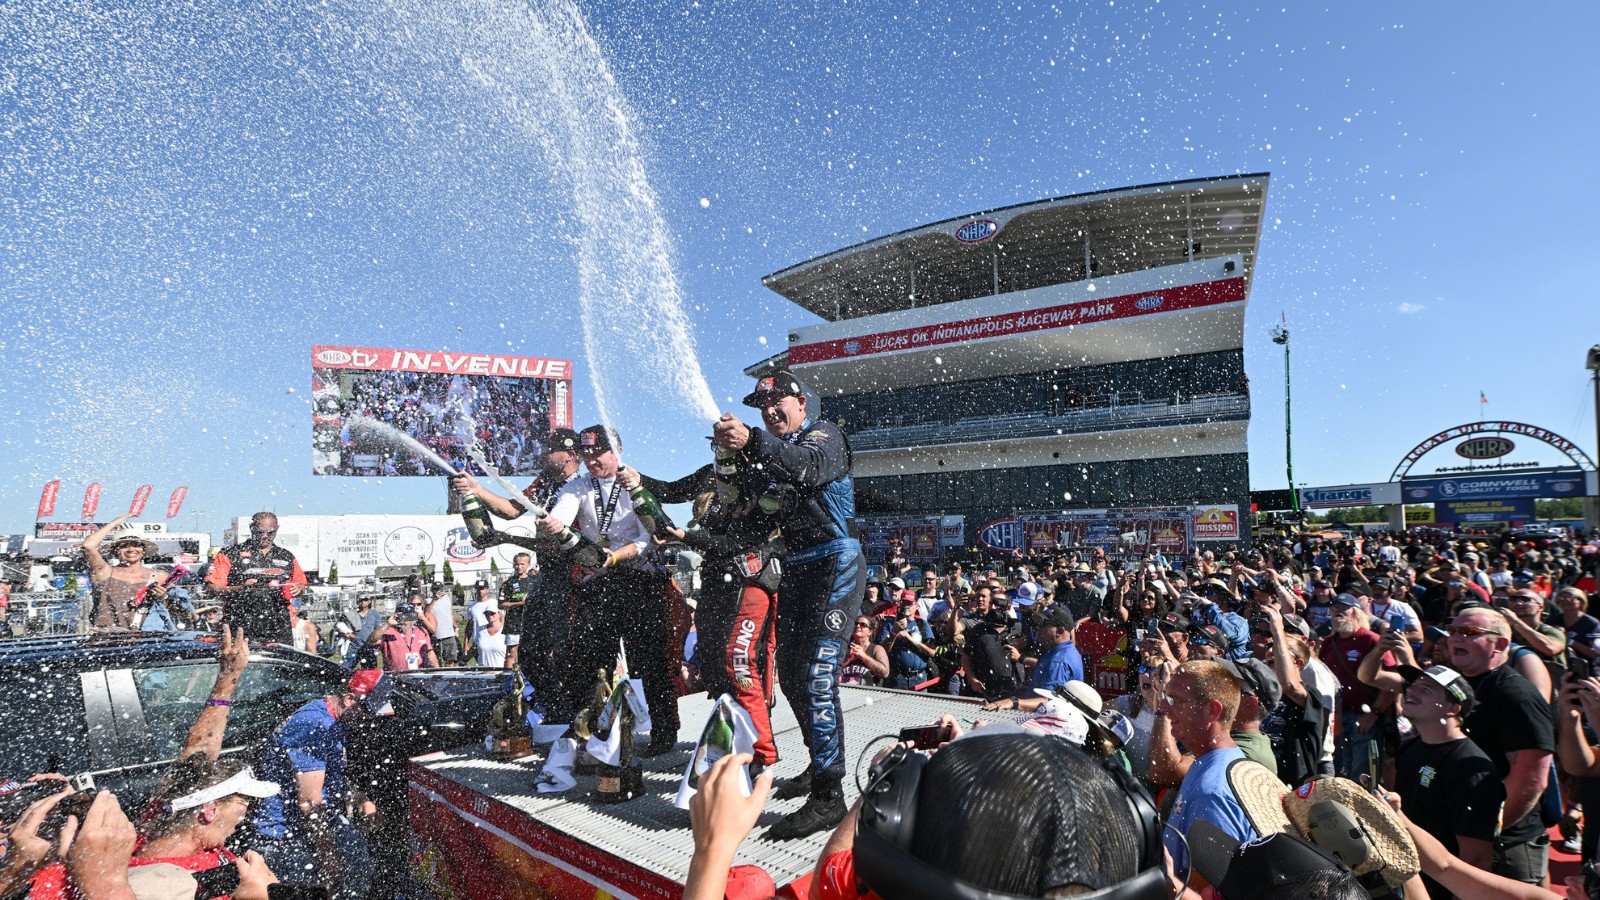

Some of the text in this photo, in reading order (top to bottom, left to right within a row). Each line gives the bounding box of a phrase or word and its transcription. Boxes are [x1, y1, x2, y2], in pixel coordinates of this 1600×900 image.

[960, 222, 995, 239] NHRA
[1137, 297, 1162, 309] NHRA
[874, 335, 909, 349] LUCAS
[912, 333, 928, 343] OIL
[932, 318, 1014, 340] INDIANAPOLIS
[1017, 309, 1078, 328] RACEWAY
[1079, 303, 1115, 319] PARK
[322, 352, 348, 361] NHRA
[391, 351, 567, 377] IN-VENUE
[1407, 422, 1575, 463] LUCAS OIL RACEWAY
[1463, 440, 1507, 457] NHRA
[1452, 461, 1539, 472] INDIANAPOLIS
[1460, 479, 1540, 489] CORNWELL
[610, 484, 620, 504] NHRA
[1303, 489, 1372, 502] Strange
[602, 511, 612, 531] NHRA
[1196, 523, 1233, 531] mission
[733, 619, 756, 682] WELLING
[852, 665, 869, 675] FAST
[579, 854, 597, 868] ROD
[601, 865, 671, 899] ASSOCIATION
